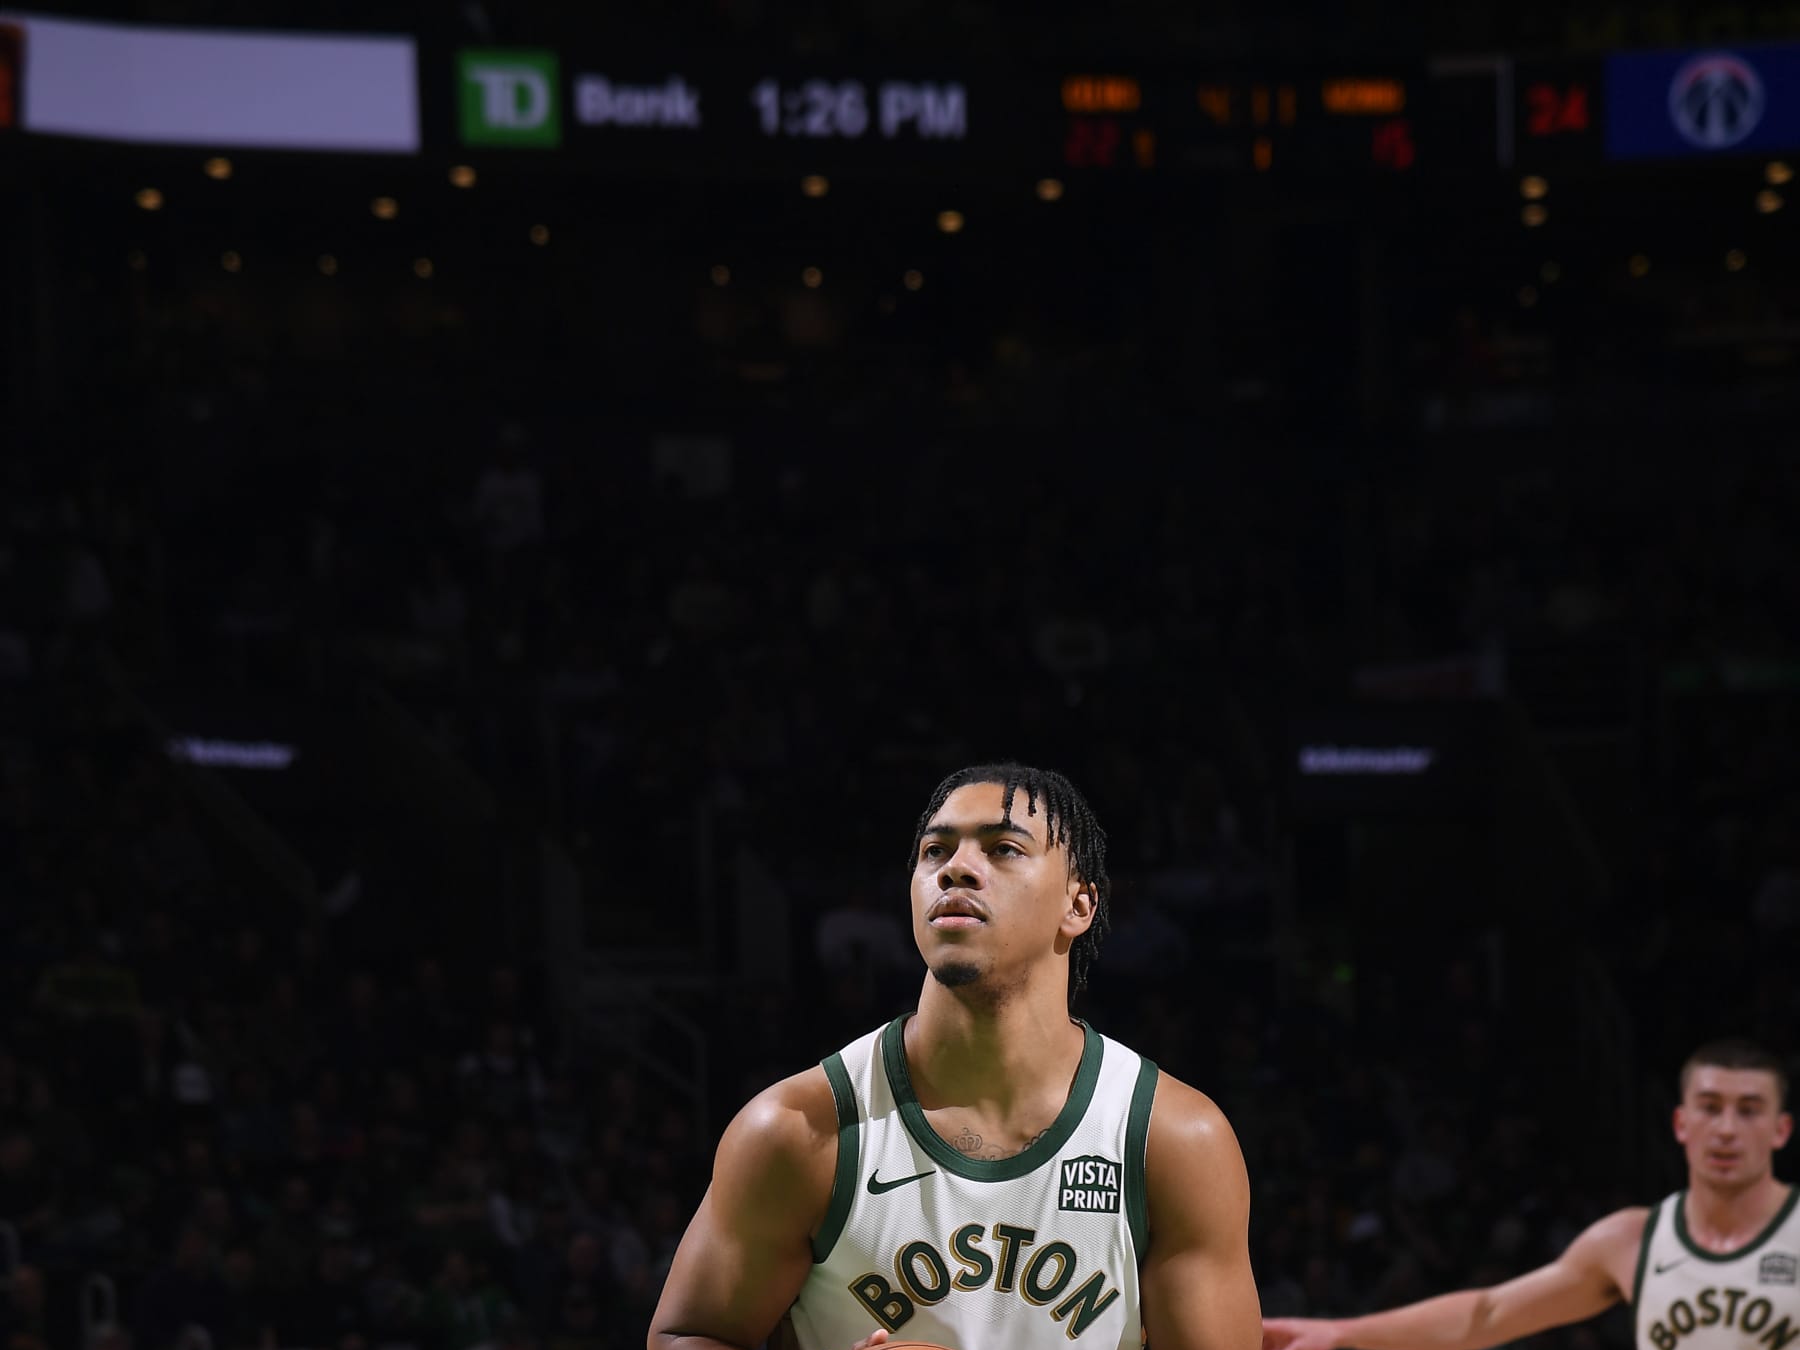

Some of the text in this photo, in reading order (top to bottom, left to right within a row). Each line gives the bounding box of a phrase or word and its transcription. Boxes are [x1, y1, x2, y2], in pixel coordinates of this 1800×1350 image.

[467, 65, 702, 130] TD Bank
[751, 79, 968, 139] 1:26 PM
[1061, 1188, 1118, 1210] PRINT
[1063, 1160, 1118, 1190] VISTA
[848, 1222, 1120, 1340] BOSTON
